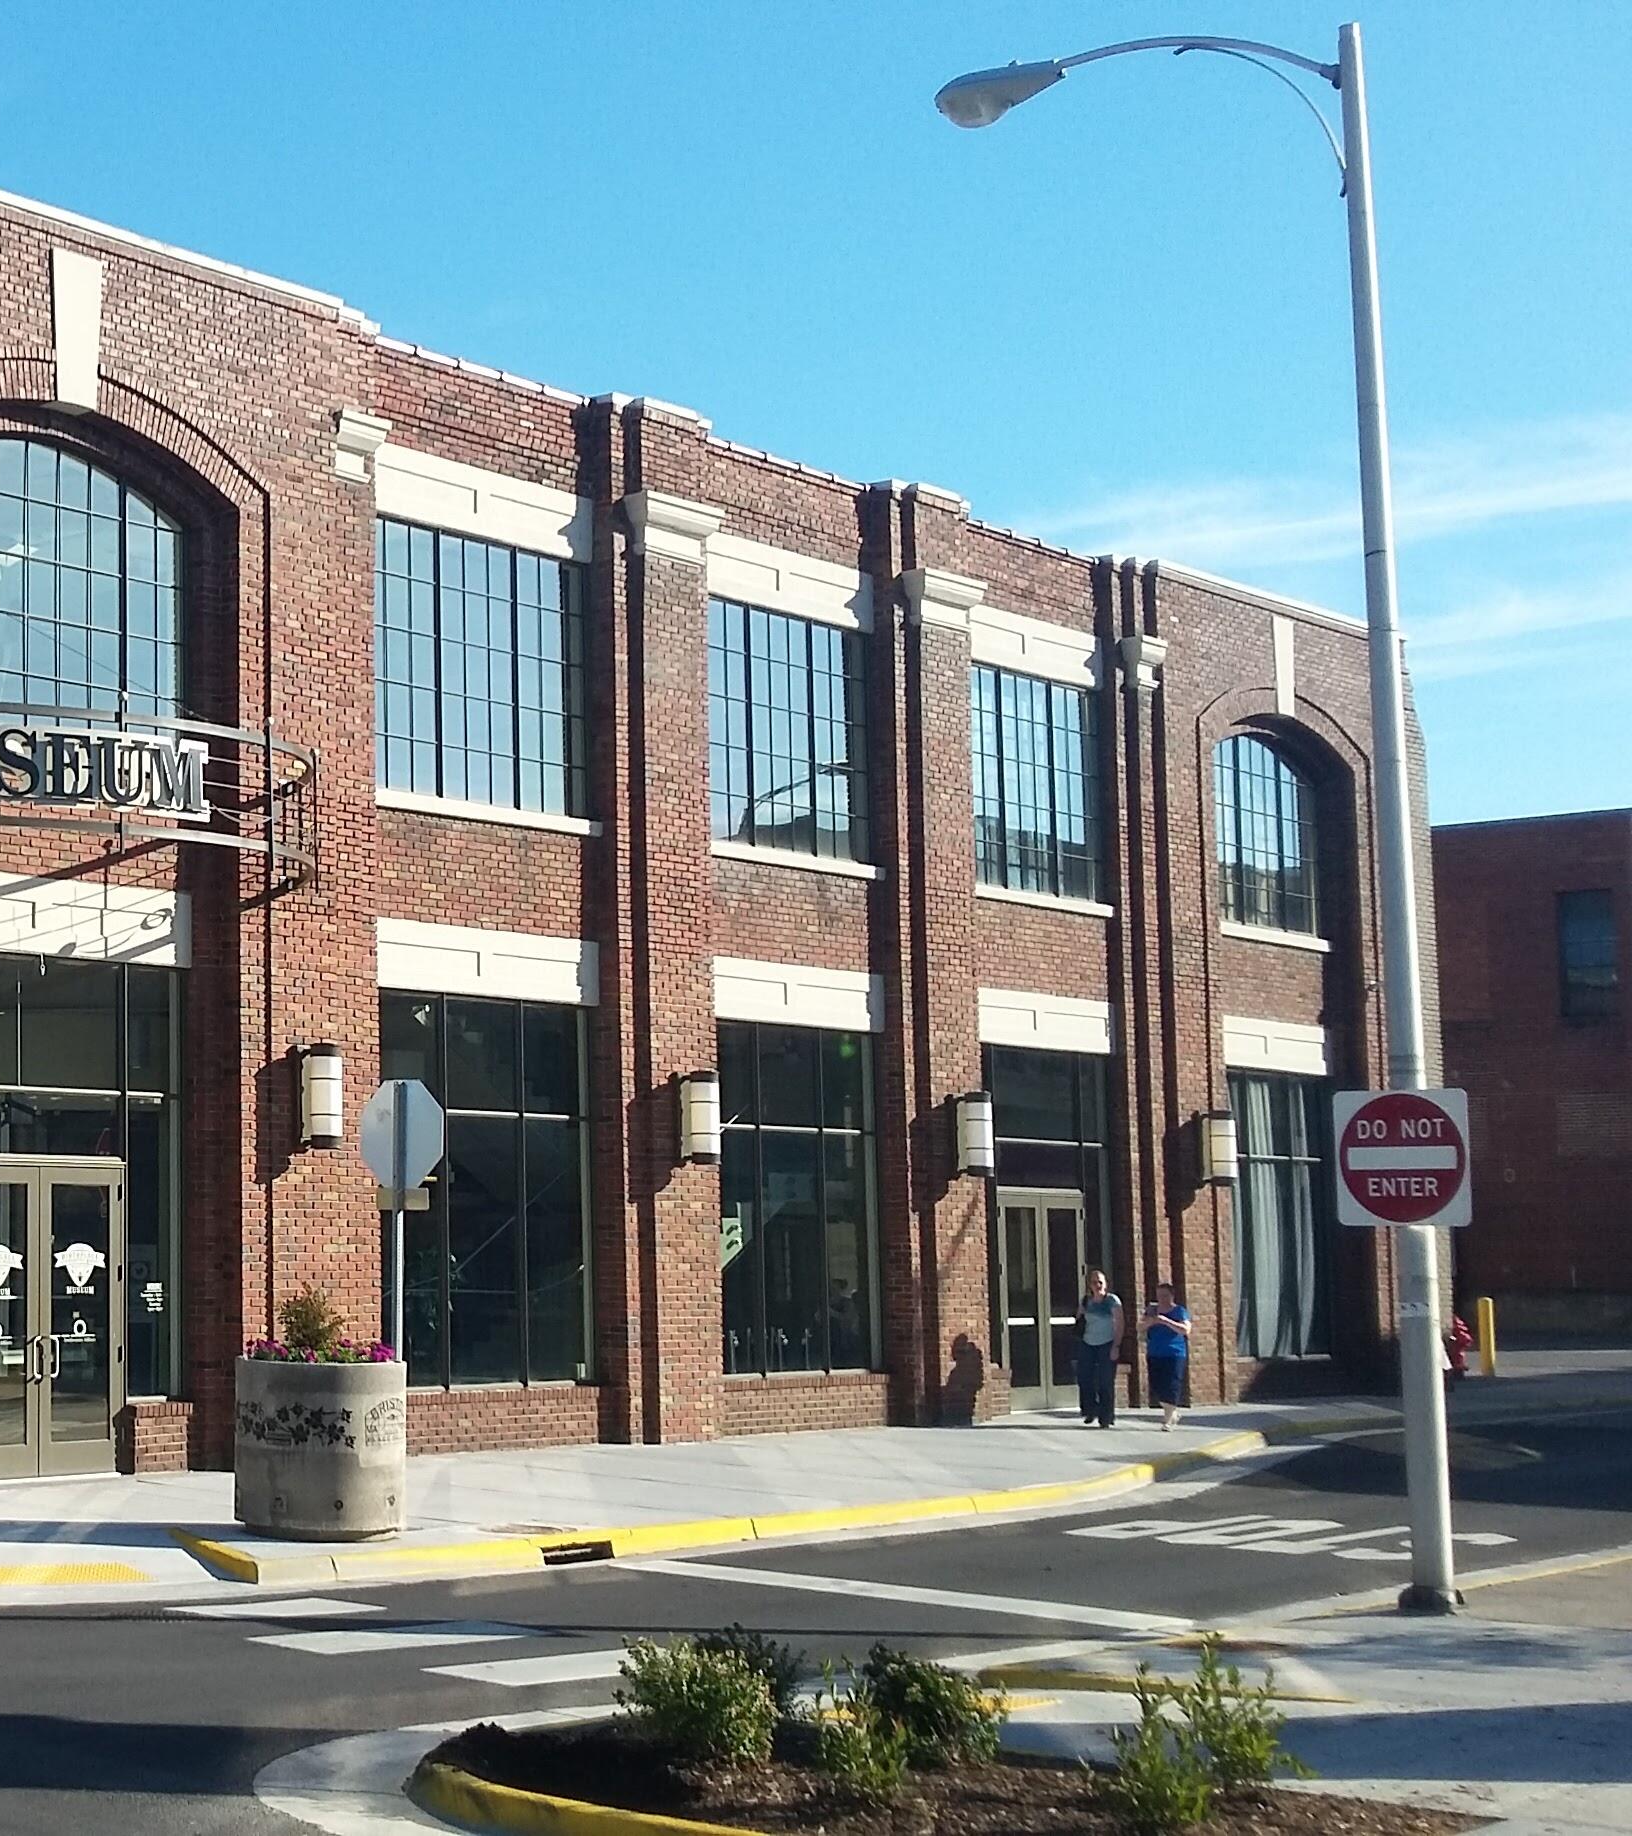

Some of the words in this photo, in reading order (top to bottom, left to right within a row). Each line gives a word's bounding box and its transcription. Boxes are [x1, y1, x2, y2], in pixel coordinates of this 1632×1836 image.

[1357, 1119, 1387, 1139] DO
[1401, 1118, 1445, 1138] NOT
[1367, 1177, 1439, 1197] ENTER
[66, 1285, 95, 1295] MUSEUM
